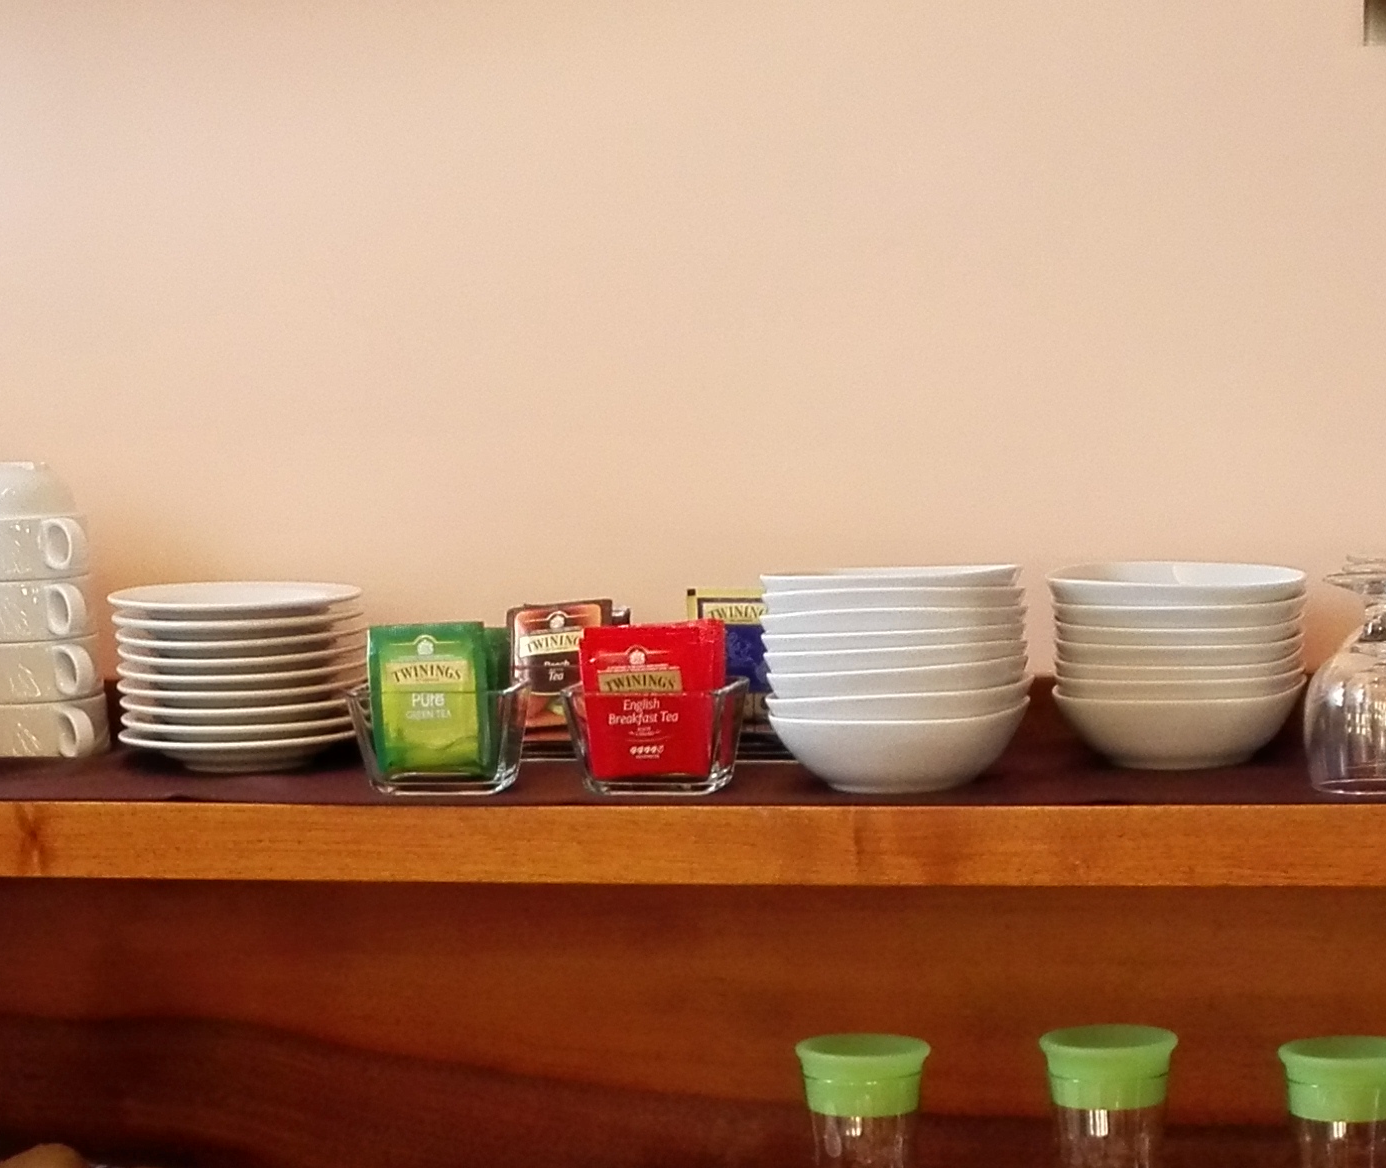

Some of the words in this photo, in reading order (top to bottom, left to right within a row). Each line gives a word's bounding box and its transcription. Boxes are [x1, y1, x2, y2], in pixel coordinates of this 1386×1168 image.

[392, 663, 461, 683] TWININGS
[604, 674, 676, 692] TWININGS
[623, 698, 660, 714] English
[406, 710, 436, 720] GREEN
[438, 709, 452, 719] TEA
[608, 712, 658, 725] Breakfast
[660, 710, 679, 722] Tea
